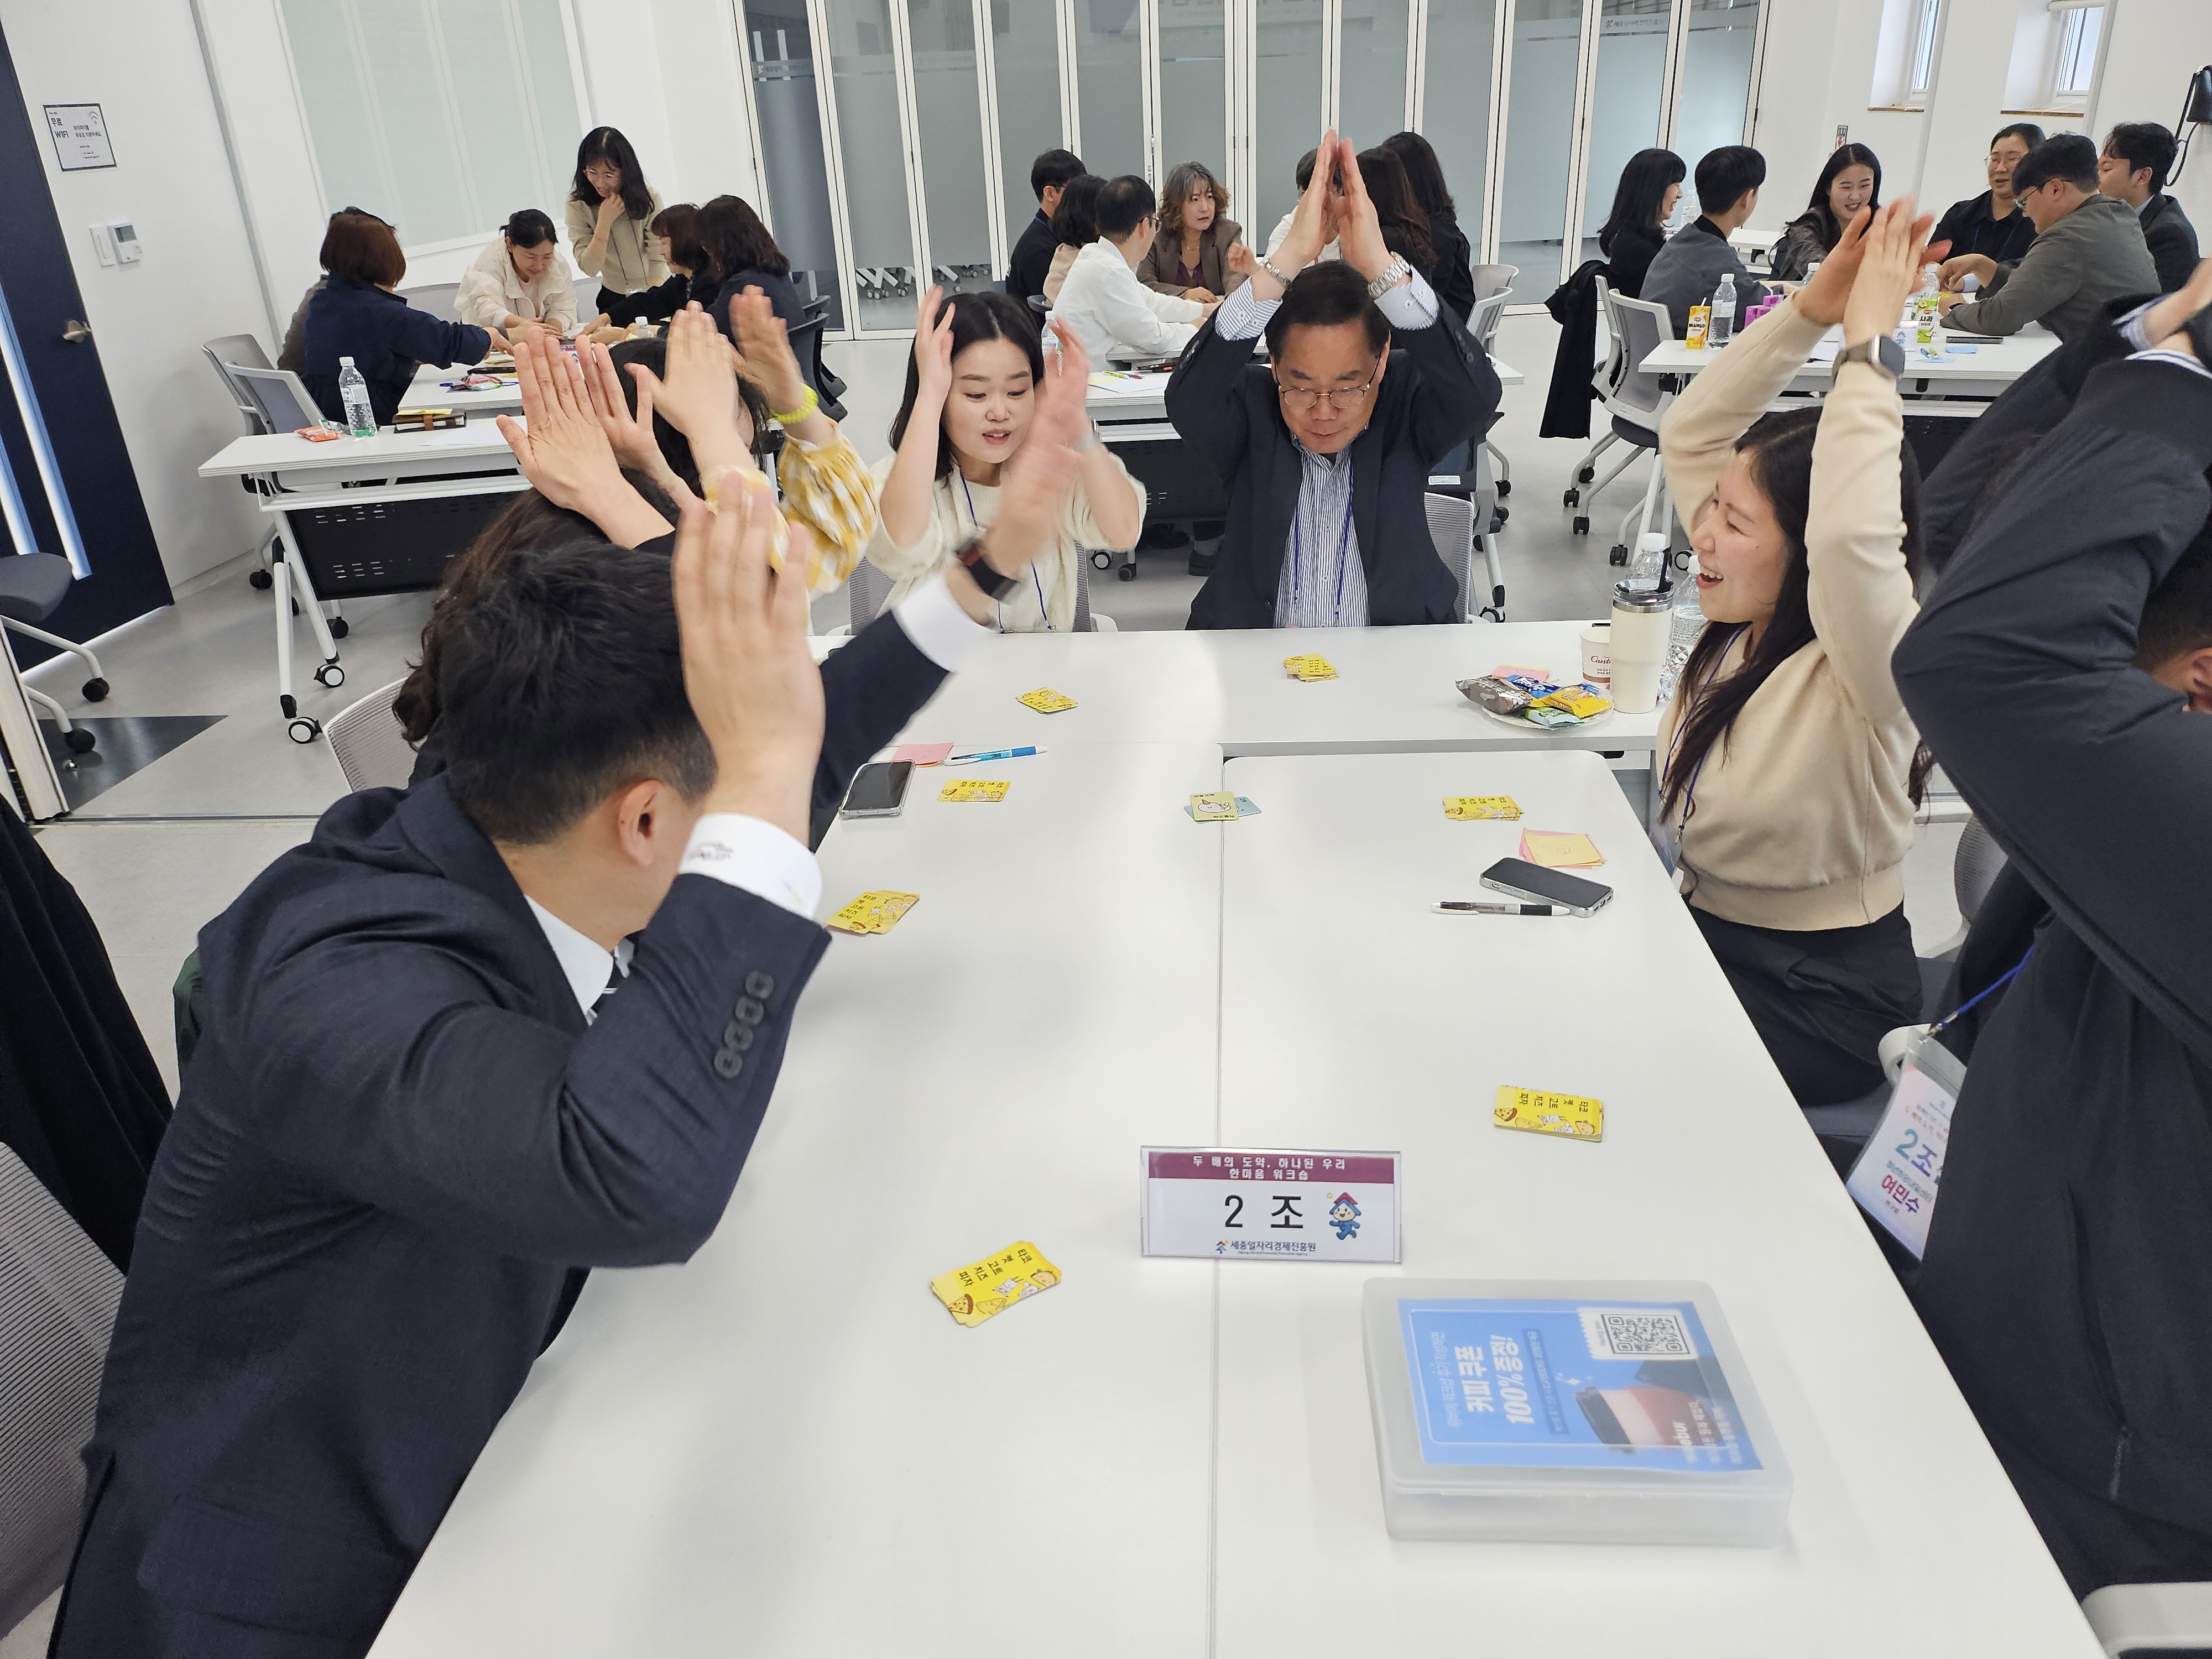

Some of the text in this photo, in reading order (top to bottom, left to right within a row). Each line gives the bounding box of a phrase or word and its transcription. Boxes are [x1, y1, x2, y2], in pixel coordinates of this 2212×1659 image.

[51, 118, 63, 127] 무료
[1519, 1093, 1528, 1105] 피자
[1534, 1095, 1544, 1107] 치즈
[1549, 1097, 1558, 1109] 고트
[1579, 1100, 1588, 1113] 타코
[1896, 1128, 1938, 1177] 2조
[1193, 1156, 1345, 1170] 두 배의 도약, 하나된 우리
[1229, 1168, 1265, 1180] 한마음
[1881, 1175, 1919, 1213] 여민수
[1225, 1194, 1303, 1229] 2 조
[1230, 1240, 1316, 1251] 세종일자리경제진흥원
[1018, 1249, 1033, 1264] 타코
[974, 1266, 989, 1281] 치즈
[987, 1261, 1004, 1275] 고트
[959, 1271, 975, 1286] 피자
[1436, 1362, 1453, 1376] 후기
[1453, 1345, 1496, 1413] 커피 쿠폰
[1487, 1334, 1535, 1423] 100% 증정!
